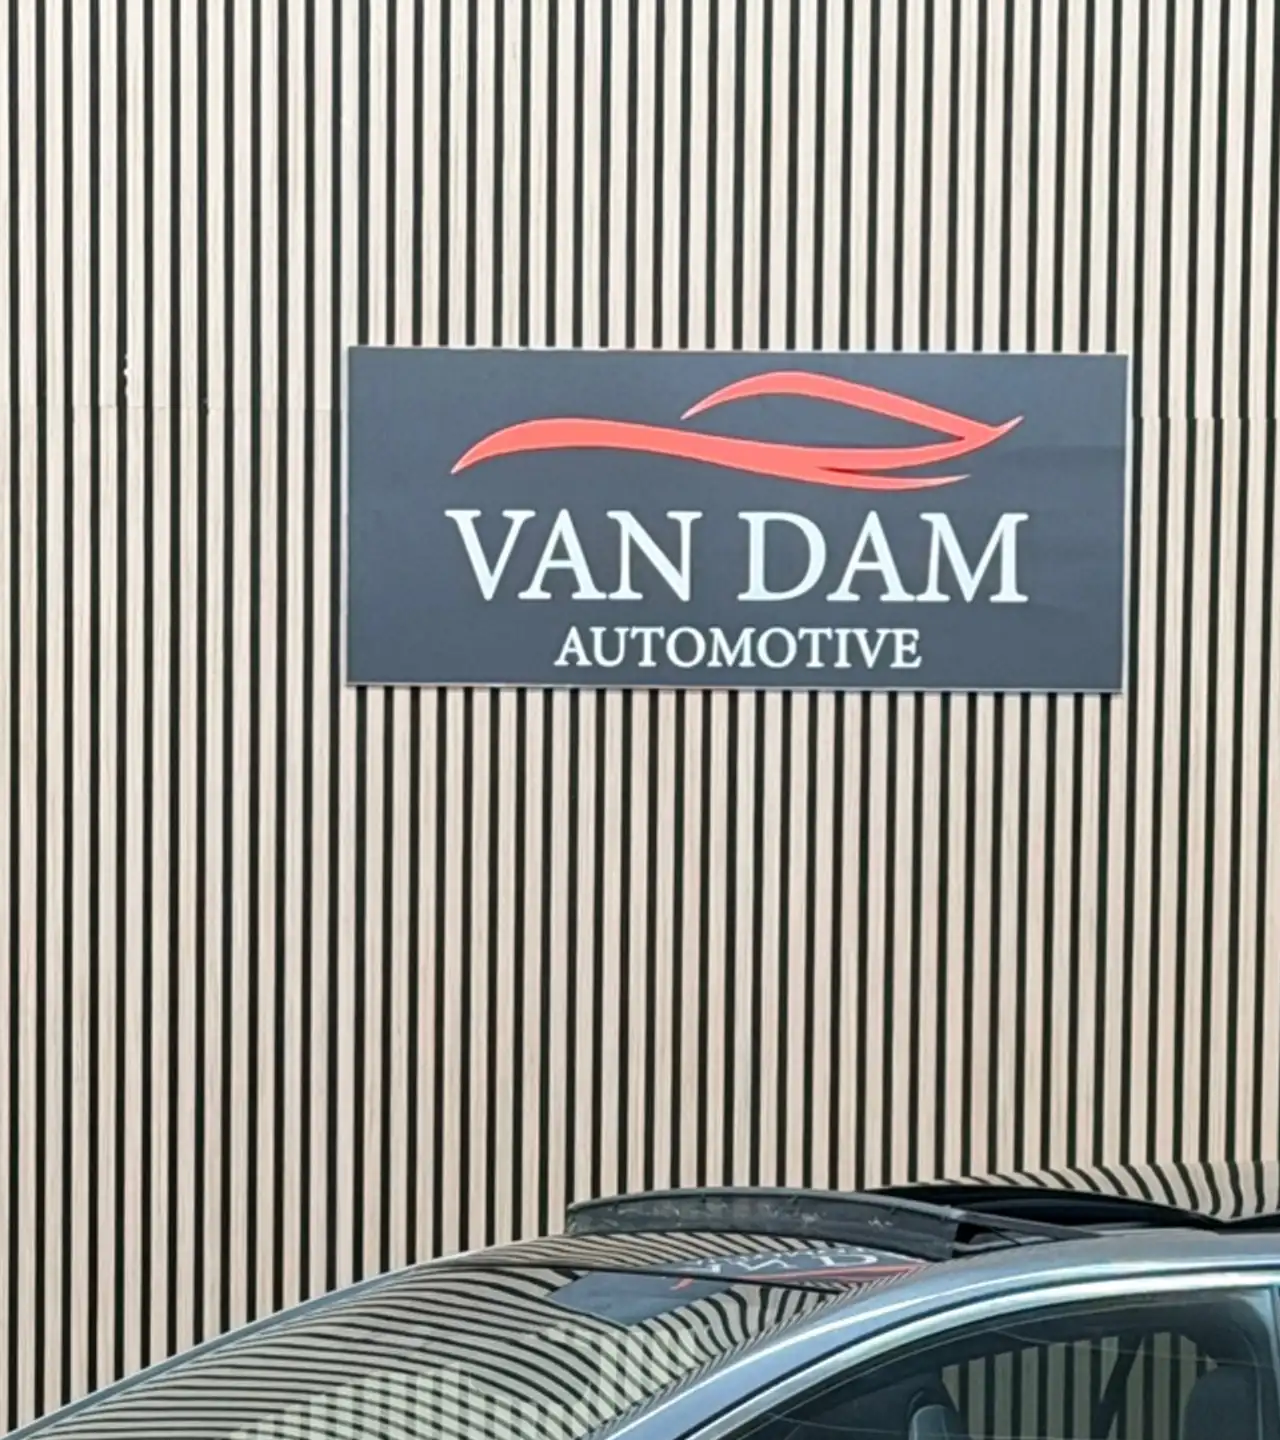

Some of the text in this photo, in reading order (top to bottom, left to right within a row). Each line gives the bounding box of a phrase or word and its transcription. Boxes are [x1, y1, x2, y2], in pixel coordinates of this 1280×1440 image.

[444, 508, 1030, 603] VAN DAM
[554, 626, 923, 669] AUTOMOTIVE
